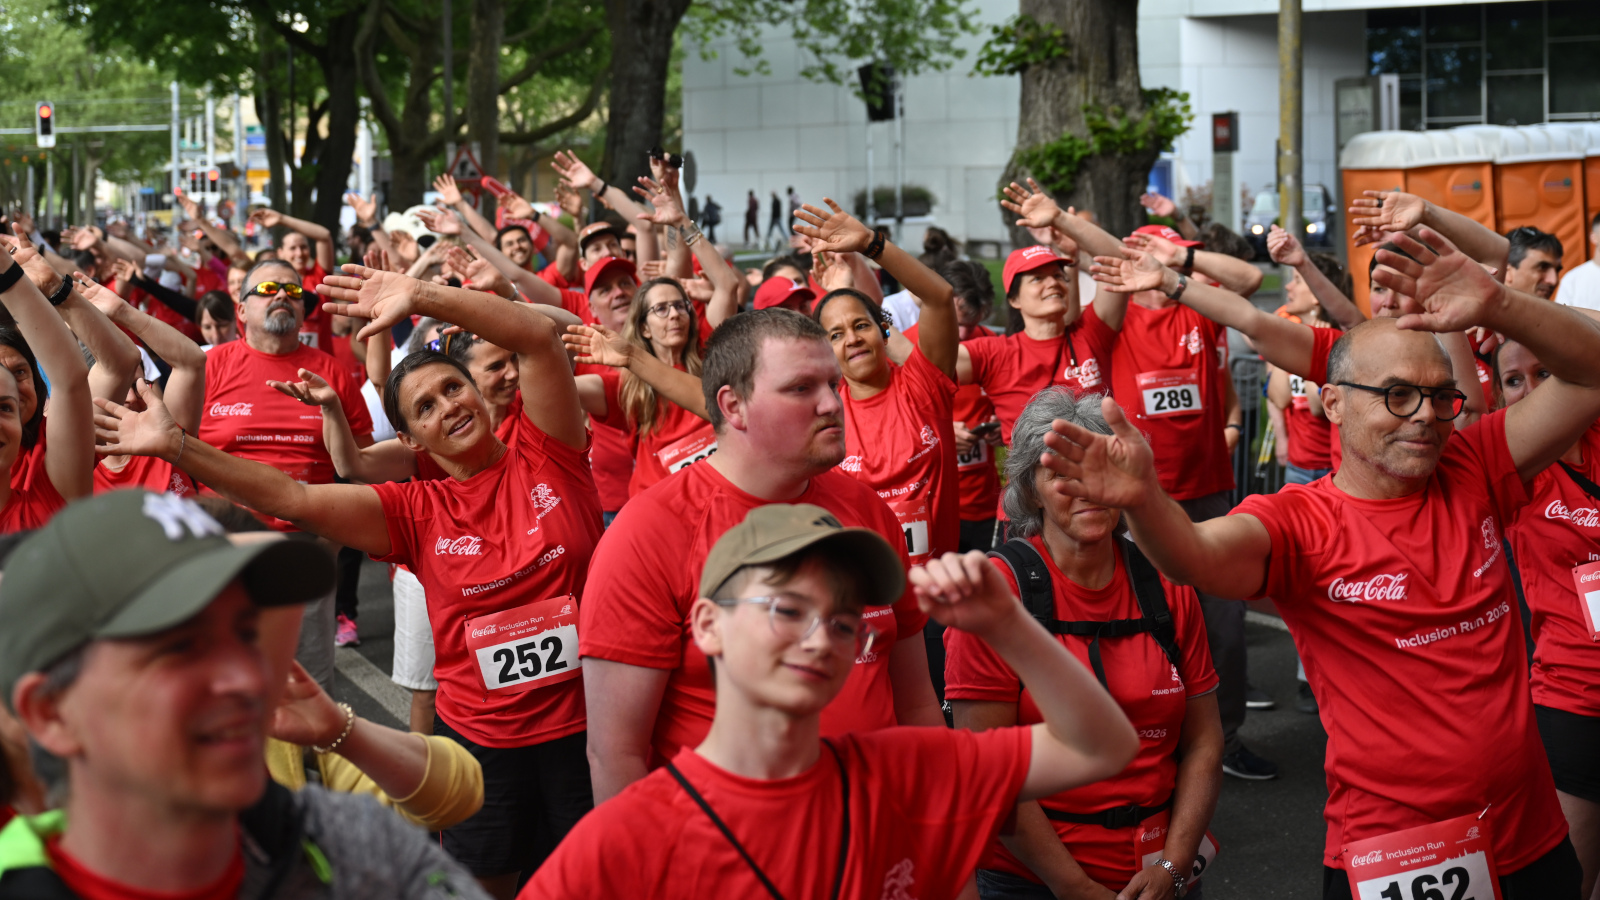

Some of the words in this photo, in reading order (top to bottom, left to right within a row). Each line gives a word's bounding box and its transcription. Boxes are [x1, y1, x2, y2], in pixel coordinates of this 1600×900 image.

[1152, 388, 1193, 411] 289
[209, 402, 254, 416] Coca-Cola
[236, 434, 274, 442] Inclusion
[275, 434, 292, 442] Run
[293, 434, 314, 442] 2026
[892, 487, 908, 497] Run
[462, 576, 513, 597] Inclusion
[514, 564, 537, 579] Run
[537, 544, 566, 567] 2026
[1580, 571, 1600, 584] Coca-Co
[1328, 573, 1408, 603] Coca-Cola
[861, 610, 879, 619] RAND
[471, 624, 498, 639] Coca-Cola
[499, 619, 529, 632] Inclusion
[530, 615, 545, 626] Run
[1395, 627, 1456, 649] Inclusion
[1459, 616, 1485, 634] Run
[1485, 601, 1510, 624] 2026
[493, 636, 568, 684] 252
[1151, 688, 1169, 696] GRAND
[1139, 728, 1167, 739] 2026
[1351, 850, 1384, 868] Coca-Cola
[1386, 846, 1426, 860] Inclusion
[1427, 840, 1445, 852] Run
[1422, 853, 1437, 862] 2026
